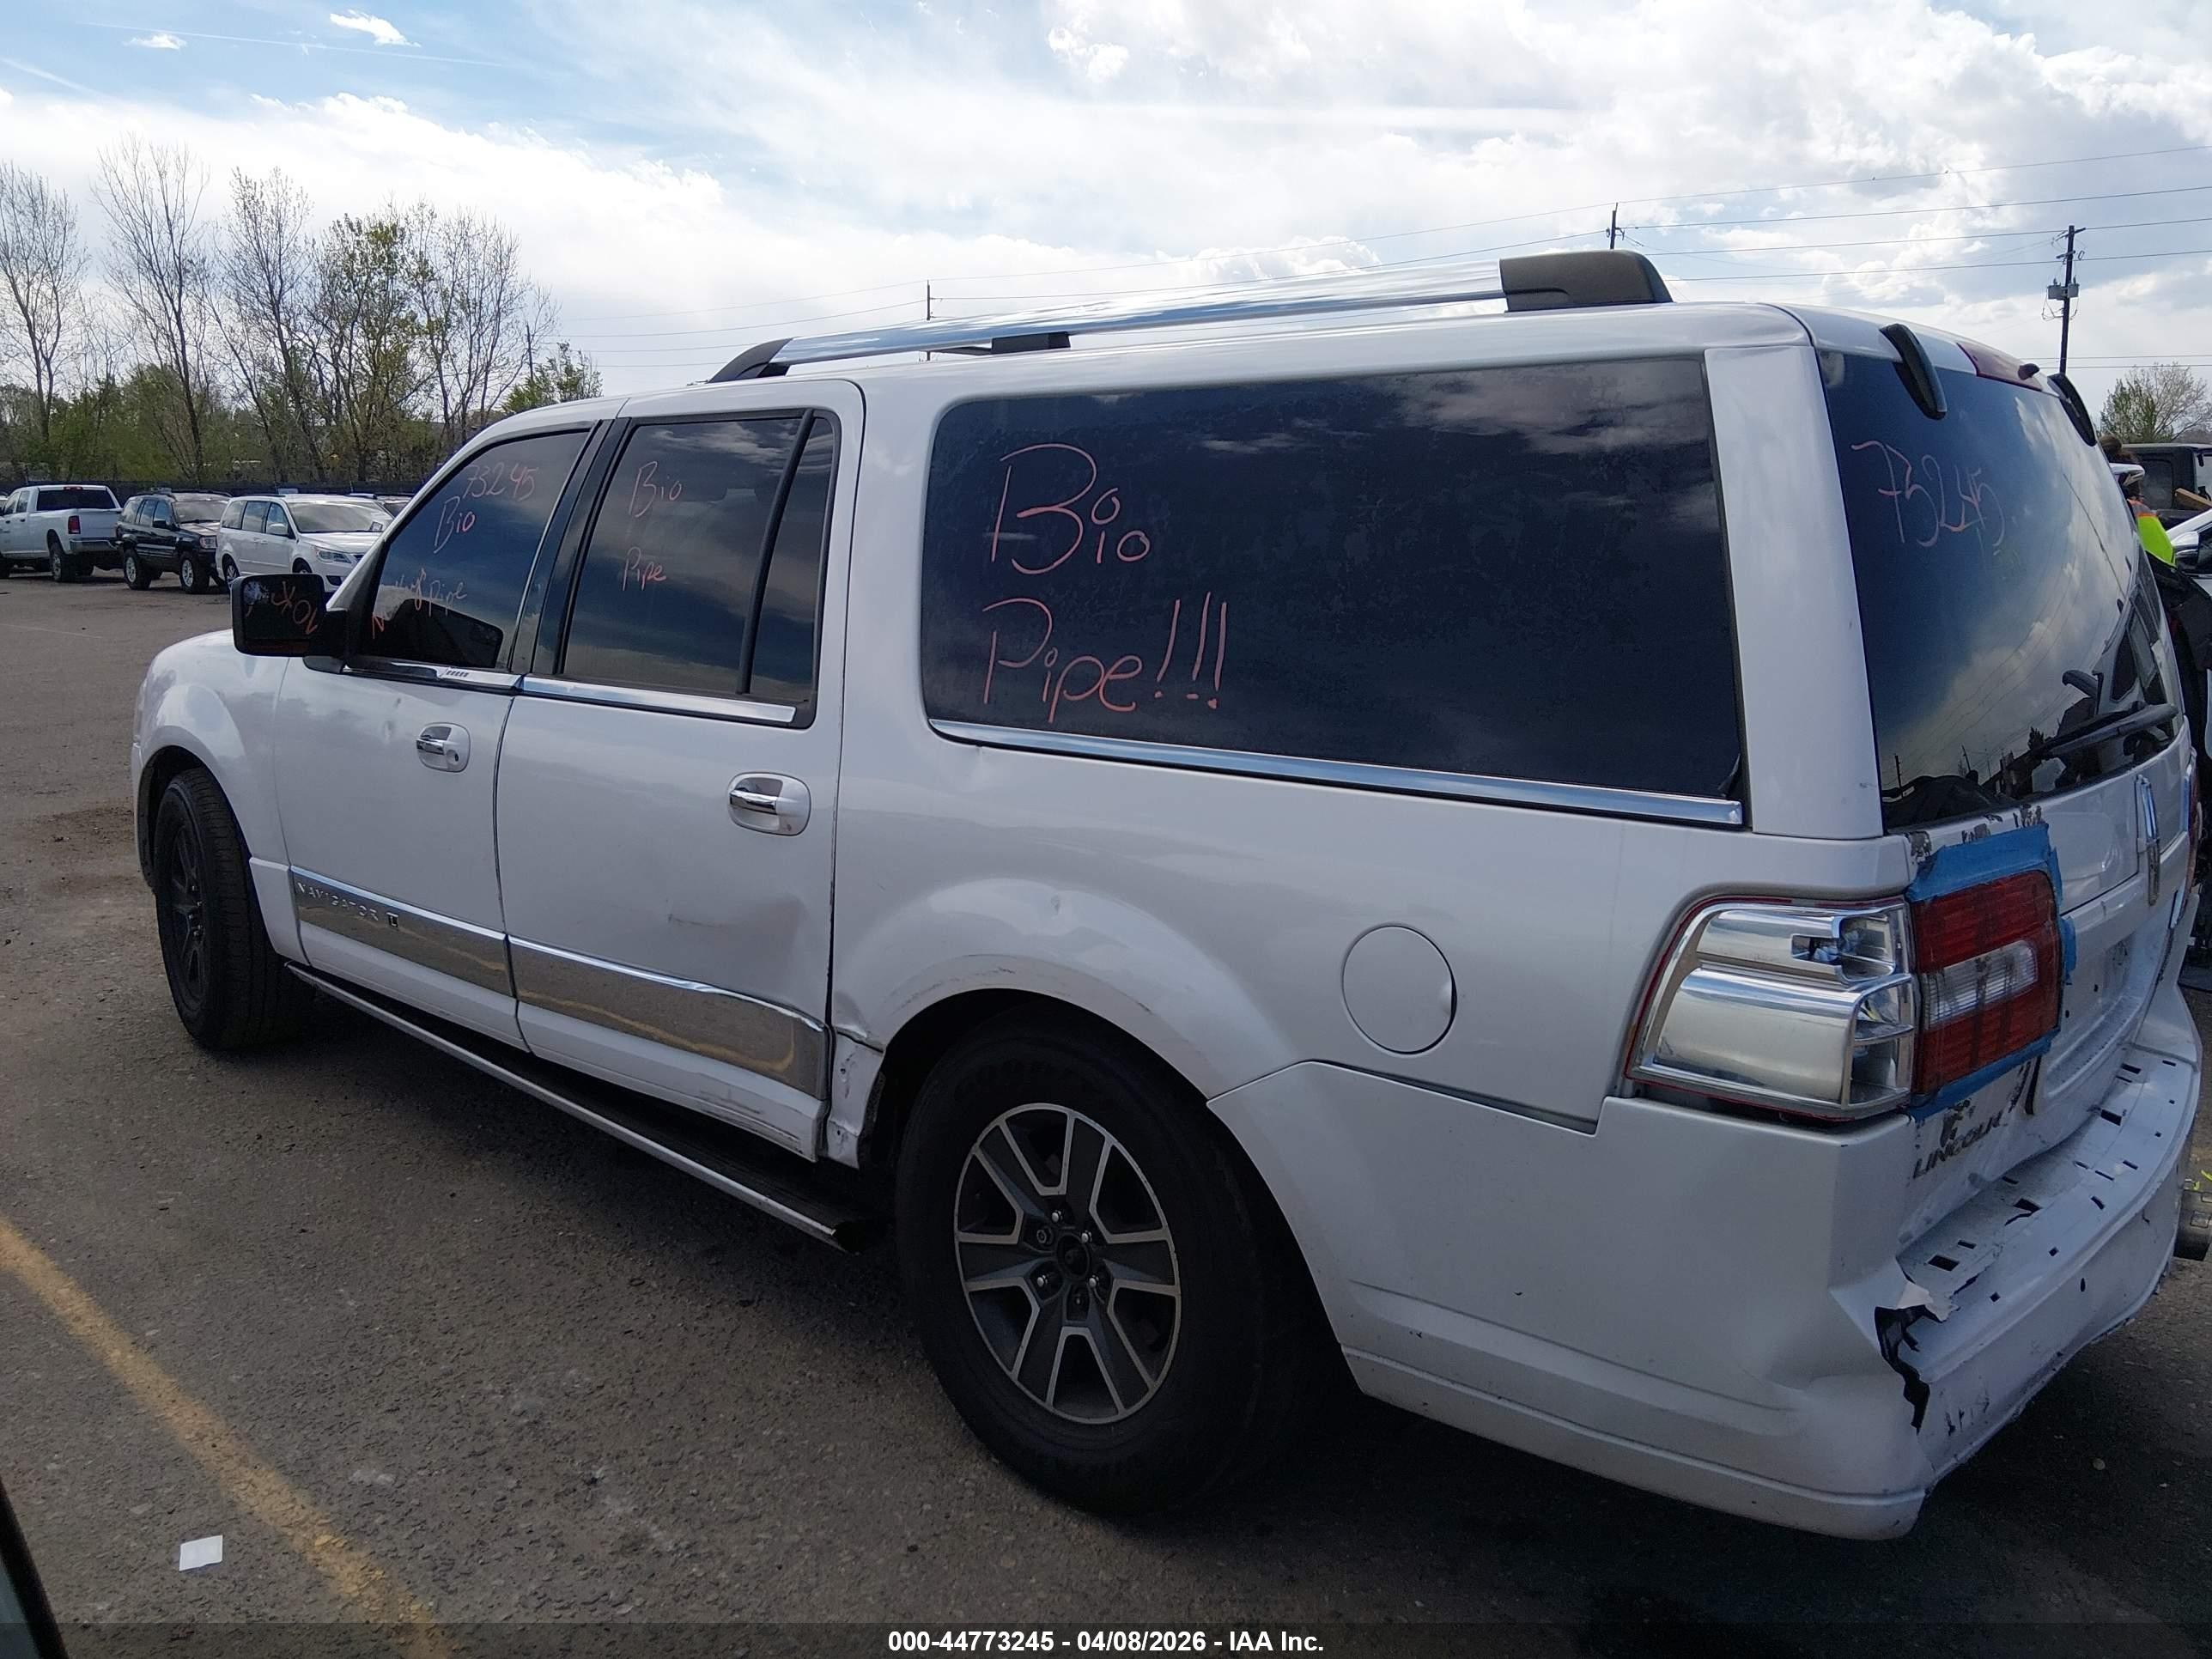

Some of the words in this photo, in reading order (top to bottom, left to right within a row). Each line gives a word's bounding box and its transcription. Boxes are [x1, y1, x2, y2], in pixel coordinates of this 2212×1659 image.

[462, 462, 539, 502] 73245
[629, 460, 683, 518] Bio
[991, 443, 1151, 575] Bio
[434, 495, 476, 554] Bio
[622, 546, 667, 592] Pipe
[982, 592, 1228, 723] Pipe!!!
[297, 882, 379, 921] NAVGAOR
